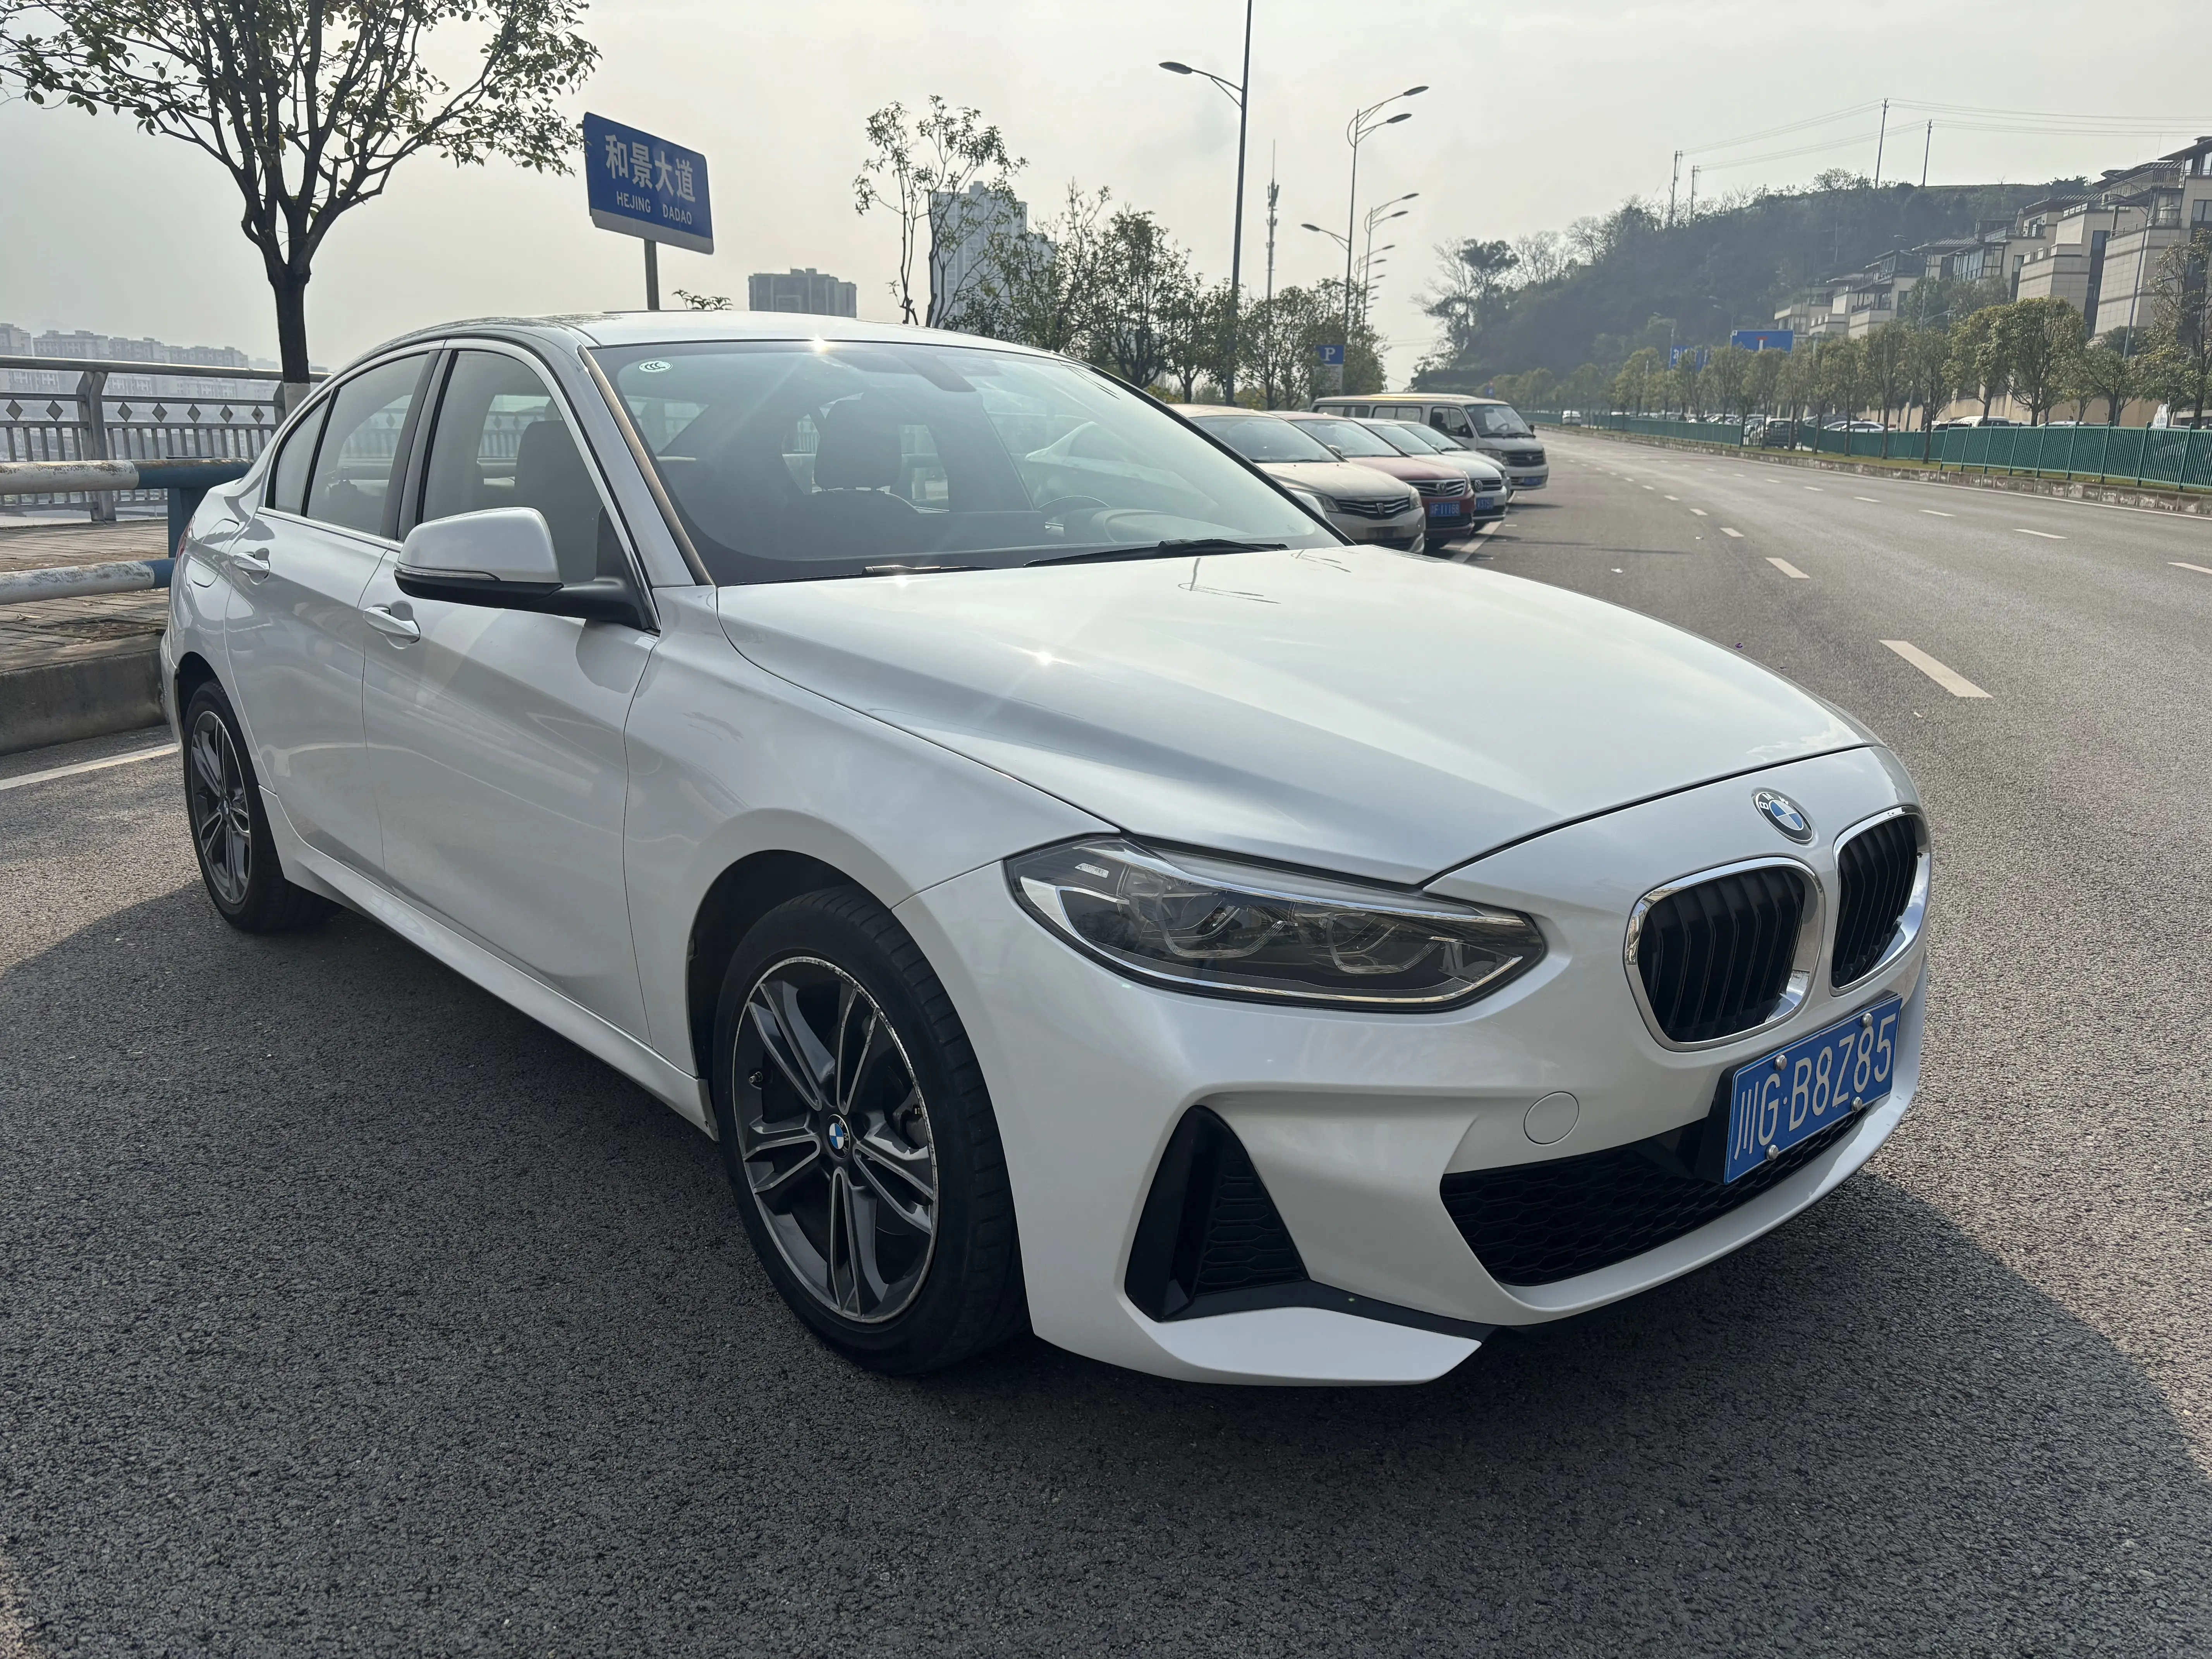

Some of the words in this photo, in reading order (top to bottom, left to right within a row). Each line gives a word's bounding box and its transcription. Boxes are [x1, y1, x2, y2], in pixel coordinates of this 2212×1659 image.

[605, 134, 696, 203] 和景大道
[616, 191, 651, 213] HEJING
[663, 204, 692, 225] DADAO
[1322, 347, 1335, 361] P
[1759, 793, 1789, 810] BMW
[1734, 1013, 1896, 1160] 川G·B8Z85
[838, 1119, 849, 1154] BMW
